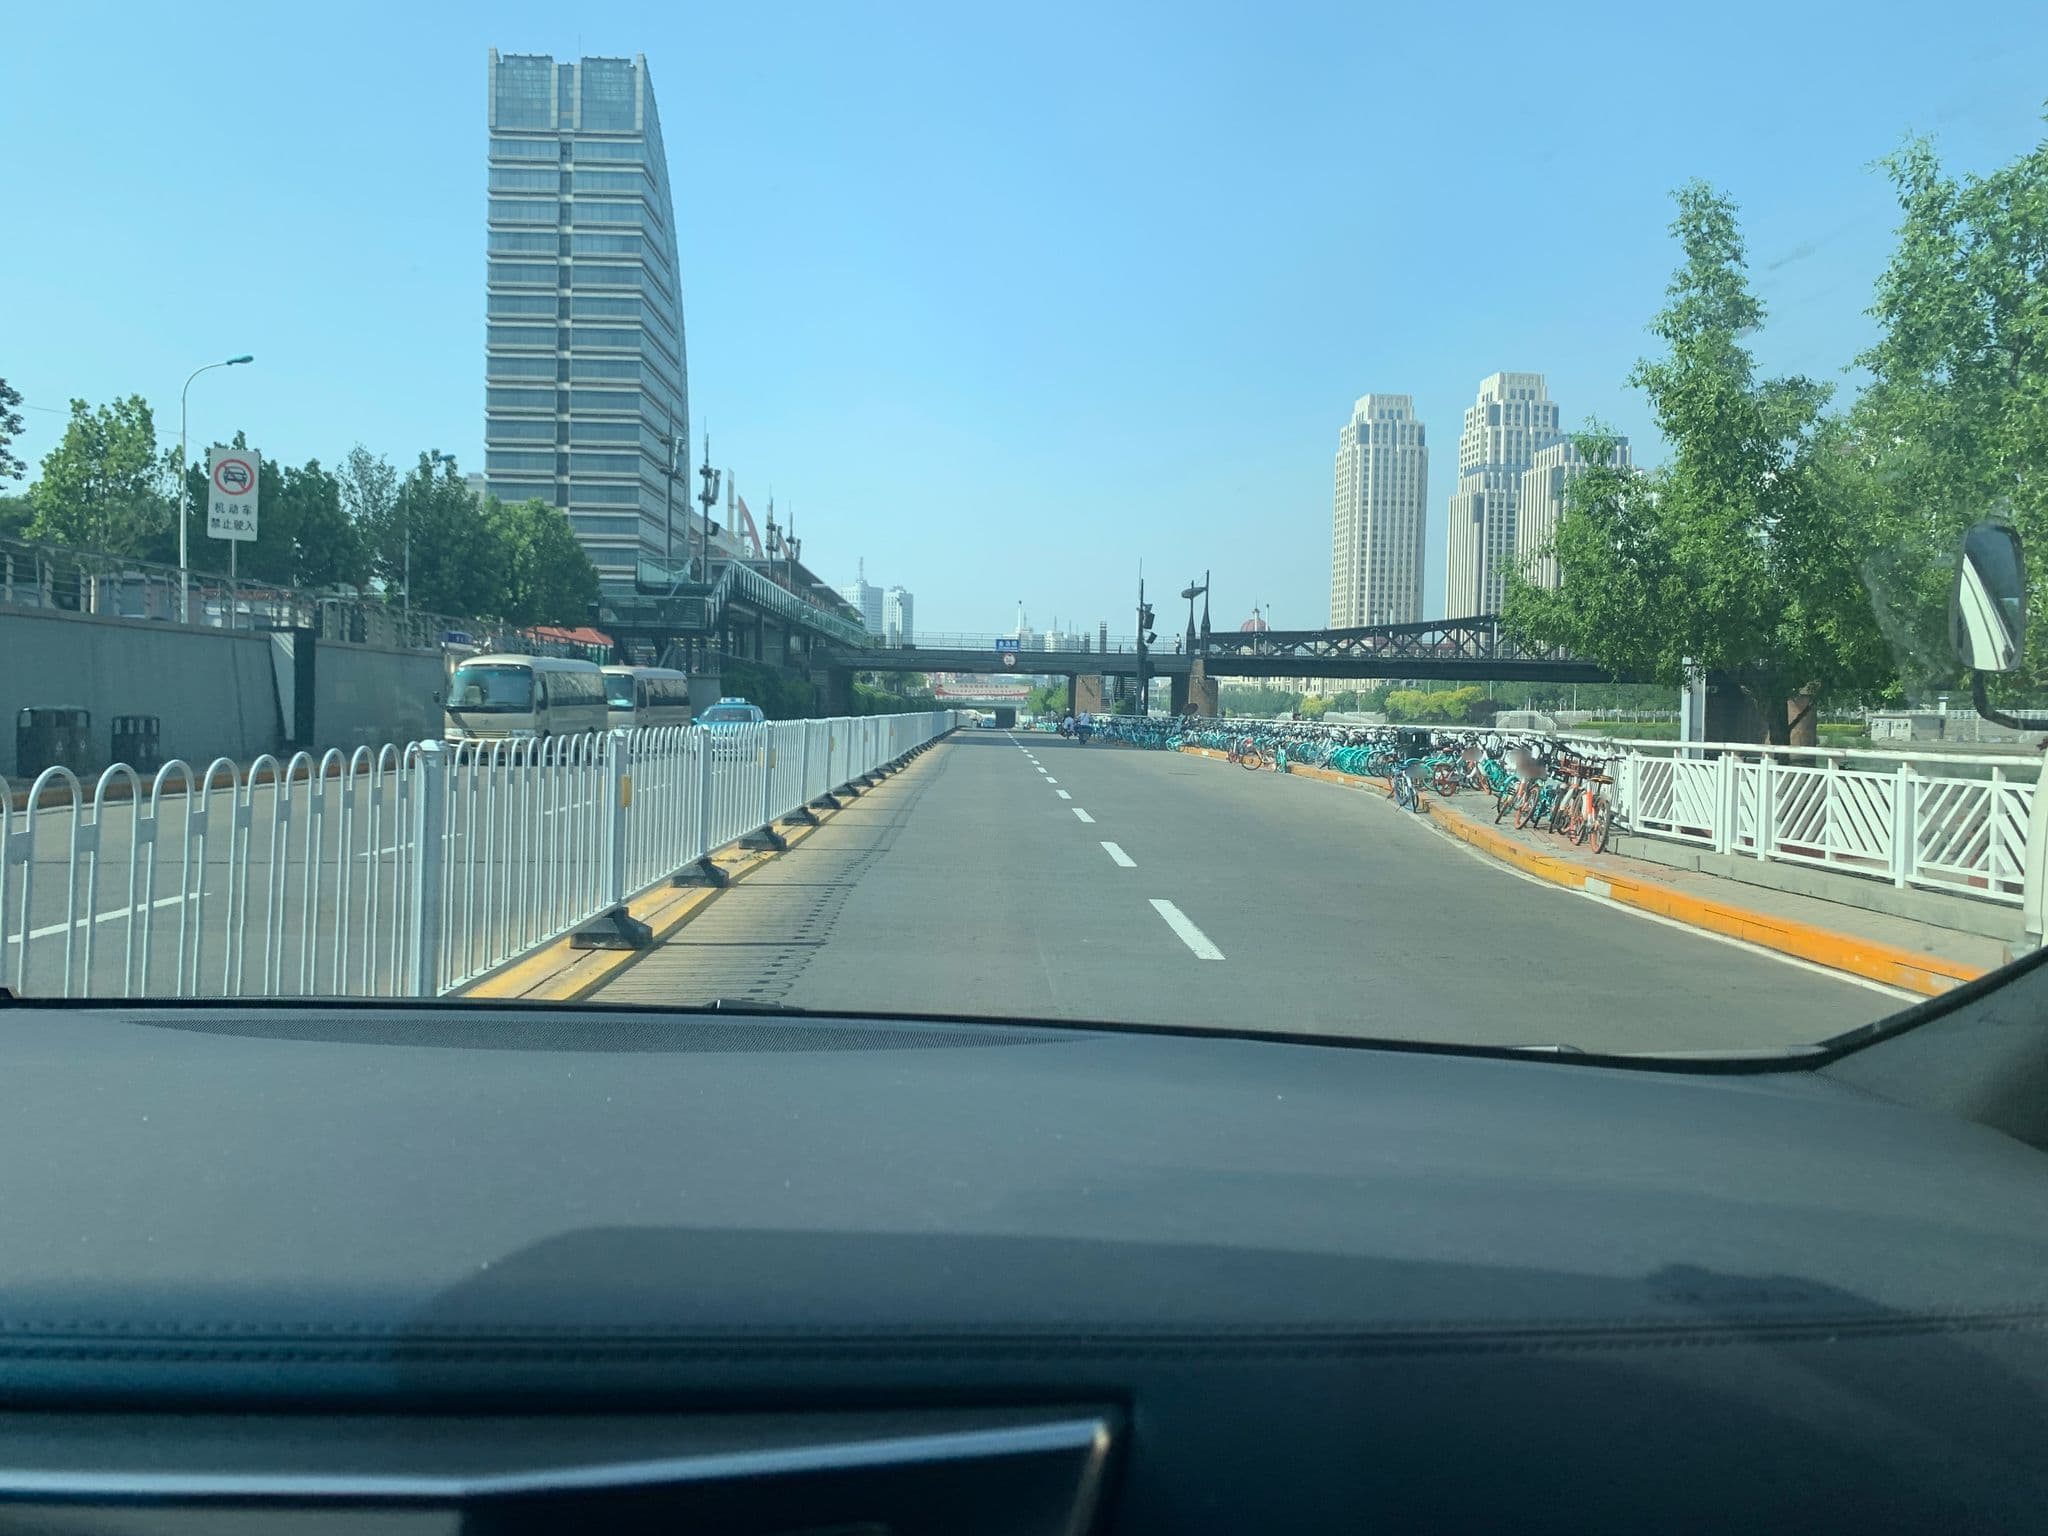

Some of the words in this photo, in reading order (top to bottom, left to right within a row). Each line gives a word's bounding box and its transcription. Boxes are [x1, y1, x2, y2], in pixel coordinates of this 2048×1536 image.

[215, 502, 252, 516] 机动车
[211, 518, 254, 532] 禁止驶入
